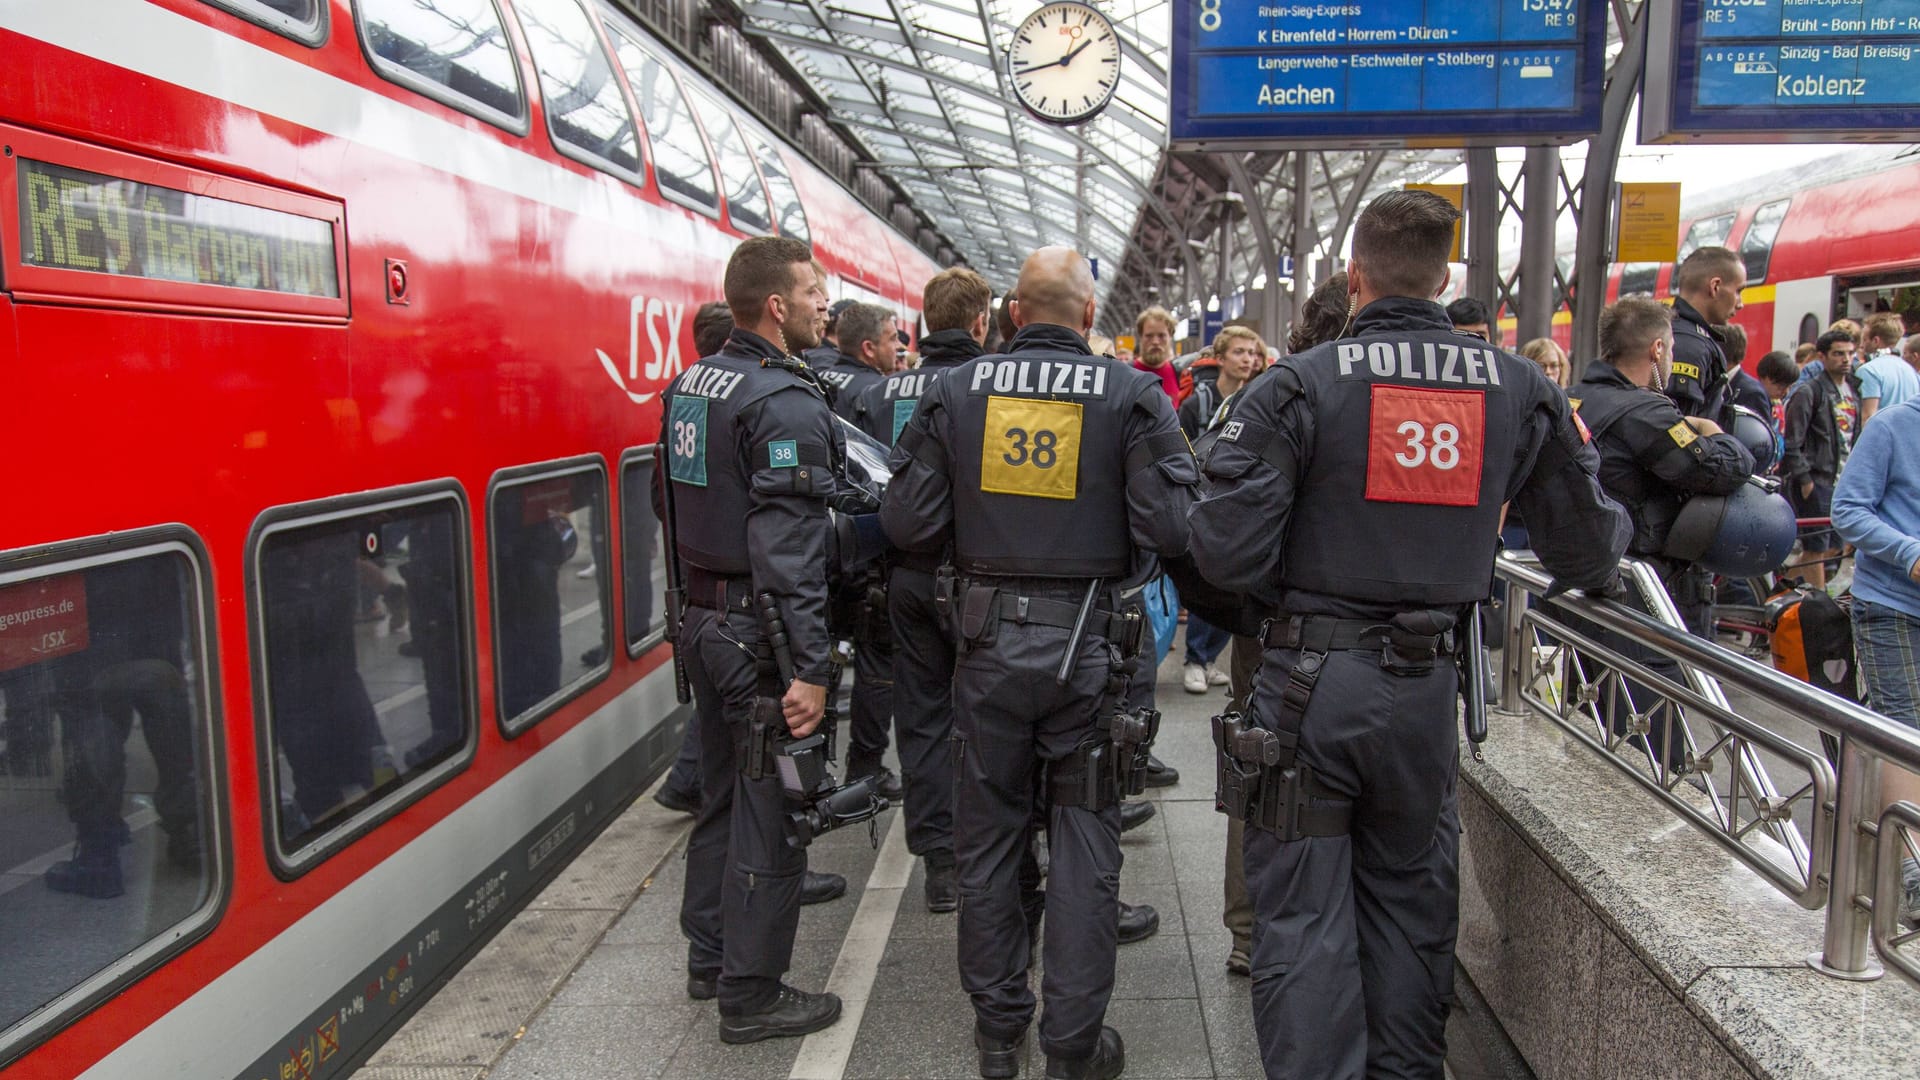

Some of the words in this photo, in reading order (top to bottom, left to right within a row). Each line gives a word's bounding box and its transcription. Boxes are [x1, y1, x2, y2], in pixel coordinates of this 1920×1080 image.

[1199, 0, 1222, 32] 8
[1258, 5, 1361, 18] Rhein-Sieg-Express
[1545, 13, 1562, 27] RE
[1566, 13, 1575, 26] 9
[1705, 10, 1723, 23] RE
[1727, 10, 1736, 22] 5
[1258, 30, 1267, 43] K
[1272, 28, 1336, 42] Ehrenfeld
[1348, 28, 1397, 41] Horrem
[1408, 26, 1448, 40] Düren
[1782, 19, 1818, 32] Brühl
[1831, 18, 1866, 31] Bonn
[1870, 18, 1896, 30] Hbf
[1258, 56, 1338, 72] Langerwehe
[1351, 53, 1424, 67] Eschweiler
[1437, 52, 1495, 68] Stolberg
[1705, 53, 1713, 61] A
[1717, 53, 1723, 61] B
[1727, 53, 1733, 61] C
[1738, 53, 1745, 61] D
[1749, 53, 1755, 61] E
[1759, 52, 1765, 61] F
[1780, 46, 1820, 62] Sinzig
[1832, 45, 1858, 58] Bad
[1863, 44, 1911, 61] Breisig
[1257, 83, 1335, 105] Aachen
[1777, 75, 1866, 96] Koblenz
[1337, 341, 1501, 386] POLIZEI
[970, 360, 1106, 396] POLIZEI
[674, 420, 696, 458] 38
[1674, 427, 1687, 438] 38
[775, 448, 792, 460] 38
[1003, 427, 1057, 469] 38
[1395, 420, 1460, 470] 38
